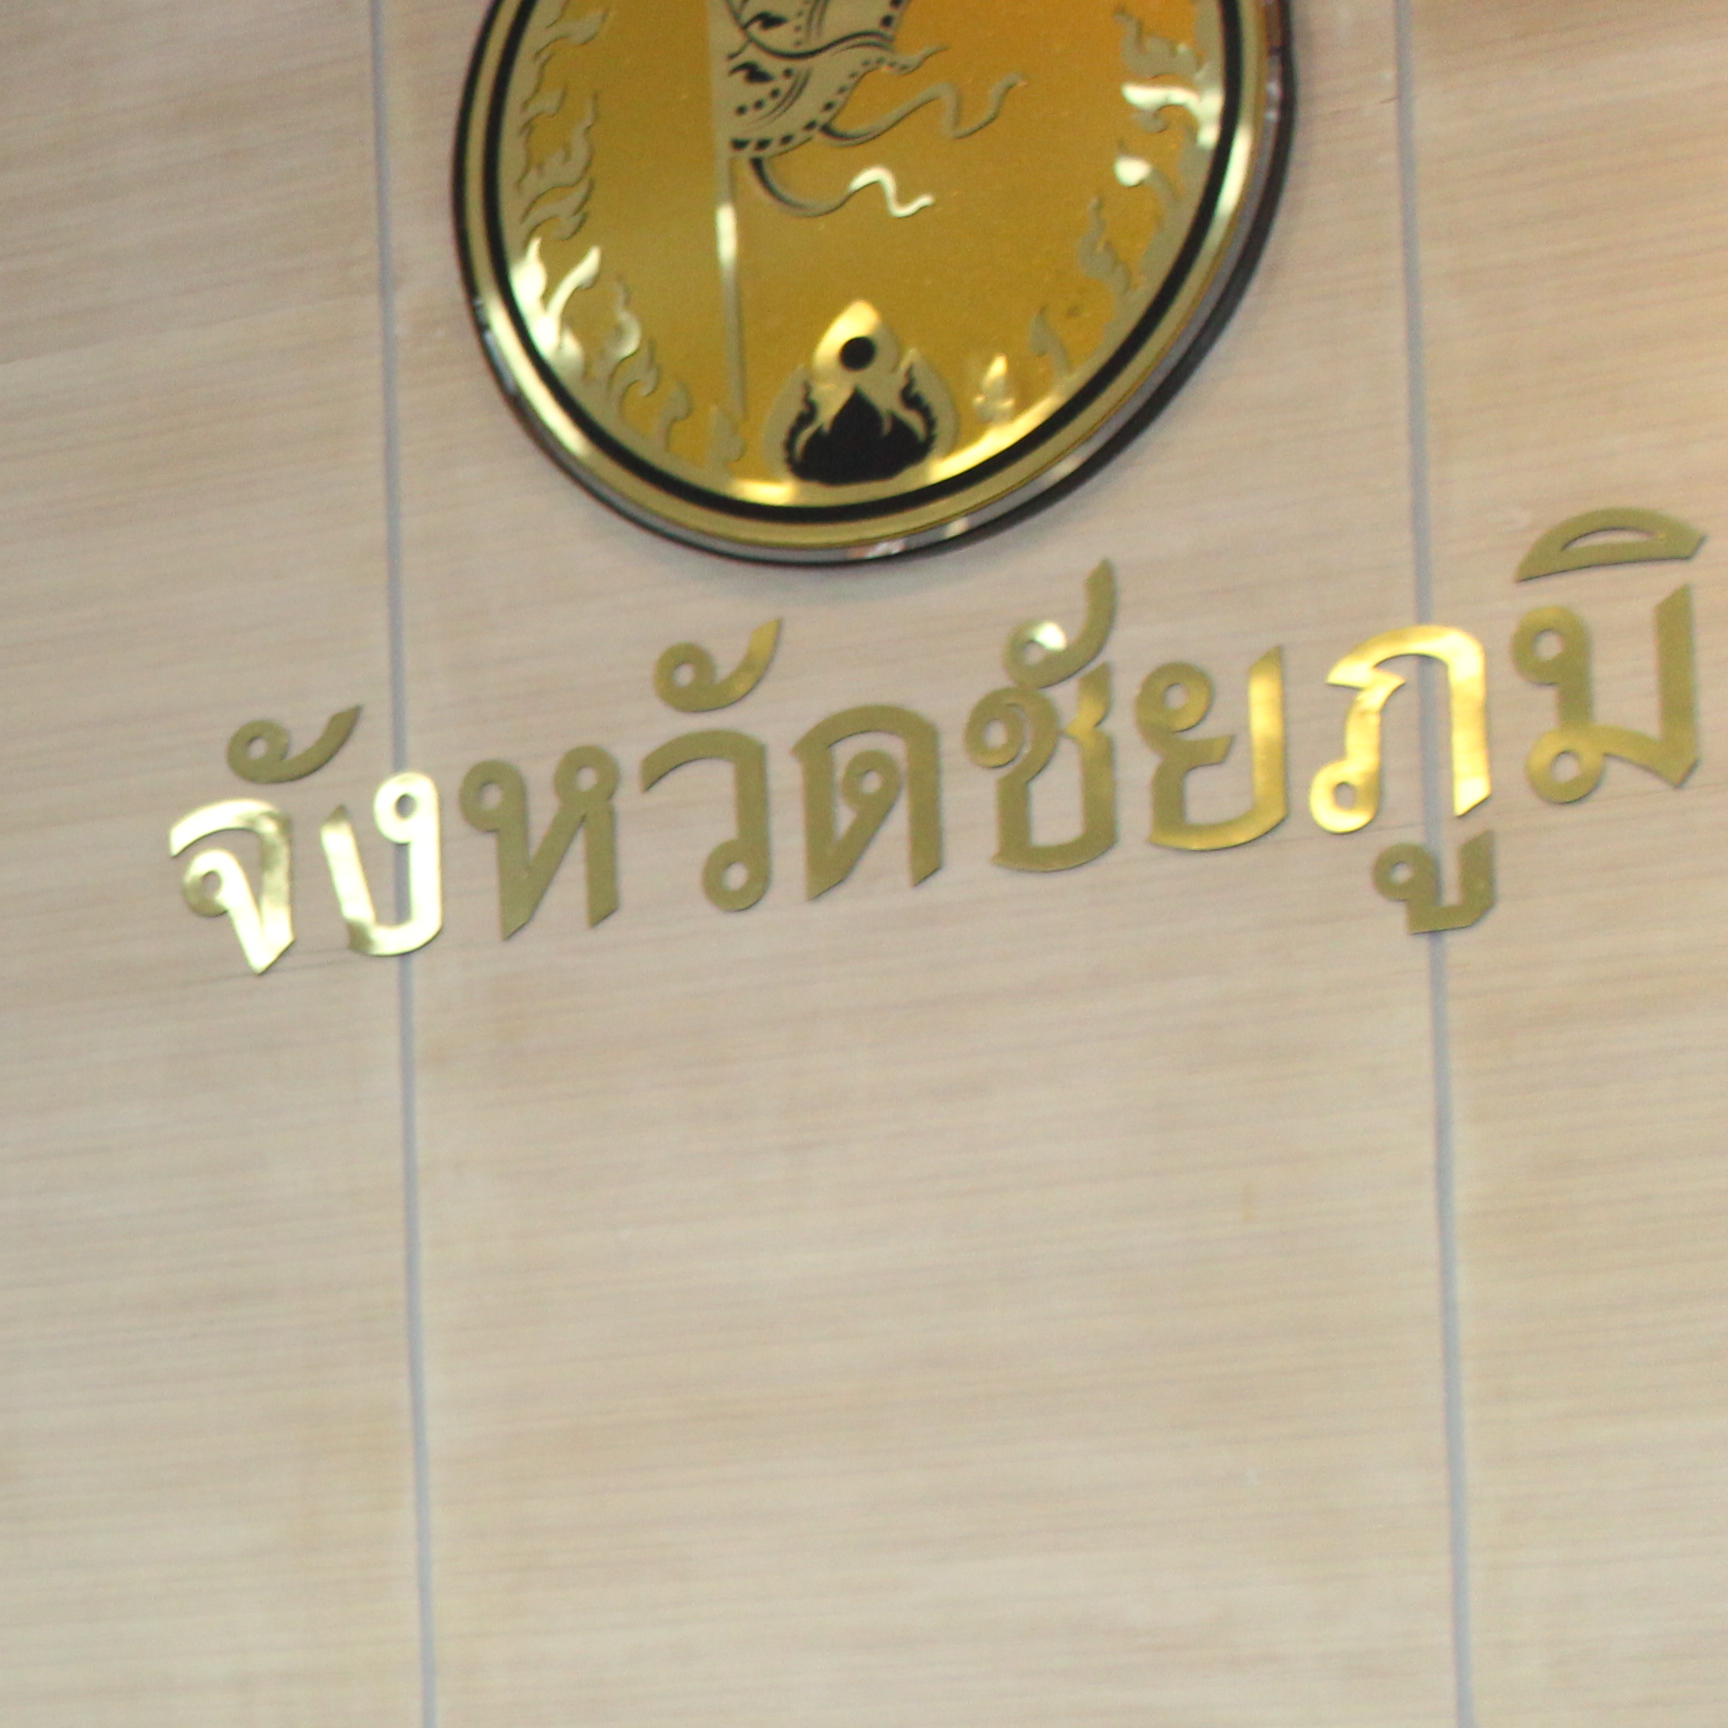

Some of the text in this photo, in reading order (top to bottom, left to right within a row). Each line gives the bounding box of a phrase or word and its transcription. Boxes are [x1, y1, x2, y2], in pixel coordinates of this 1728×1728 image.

[164, 505, 1705, 976] จังหวัดชัยภูมิ
